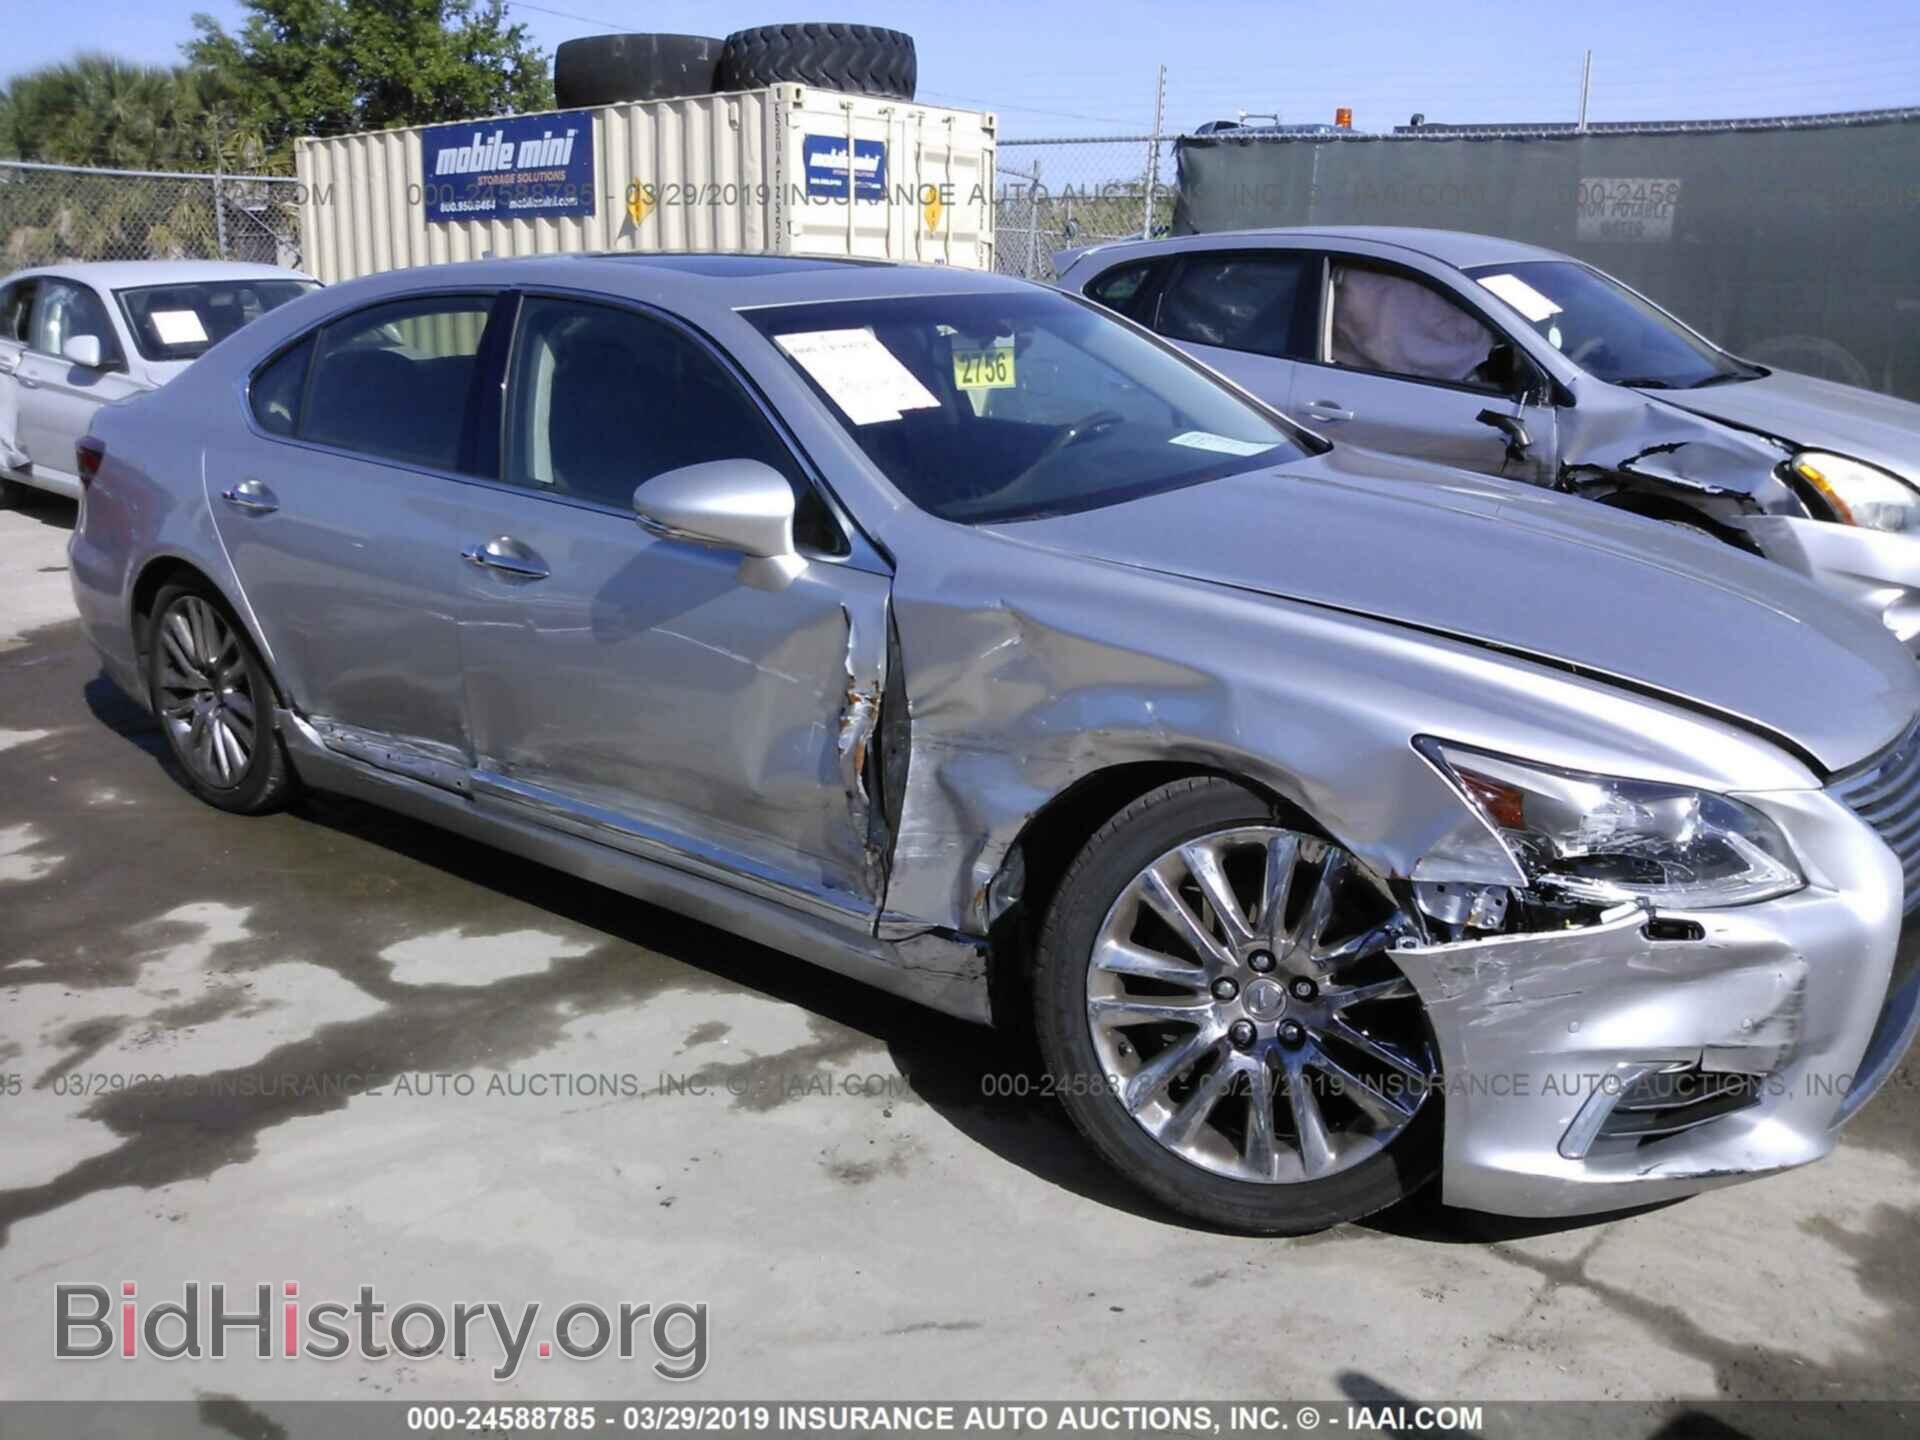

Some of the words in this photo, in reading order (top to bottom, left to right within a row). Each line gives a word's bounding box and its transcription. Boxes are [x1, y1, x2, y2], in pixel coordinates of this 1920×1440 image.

[435, 130, 515, 175] mobile
[516, 128, 577, 168] mini
[516, 170, 566, 182] SOLUTIONS
[961, 353, 1008, 384] 2756
